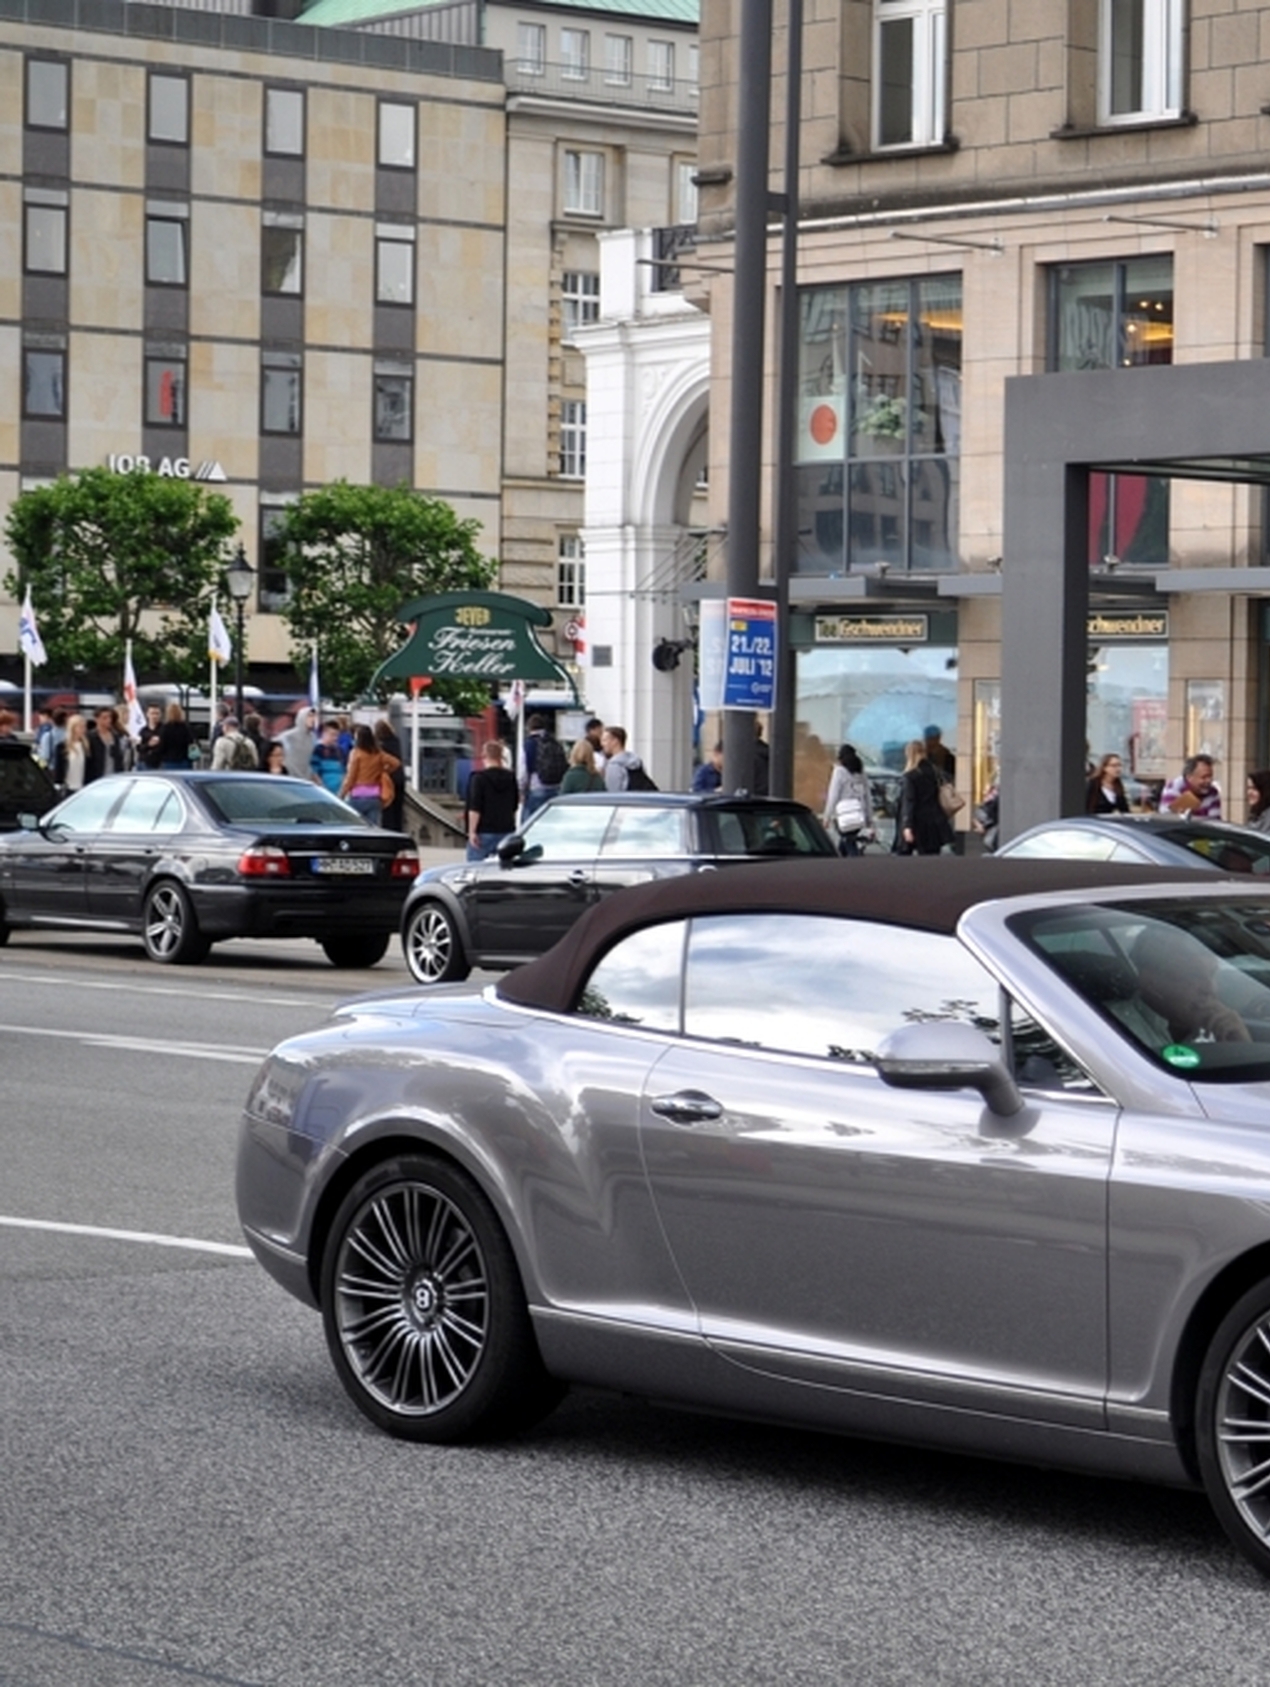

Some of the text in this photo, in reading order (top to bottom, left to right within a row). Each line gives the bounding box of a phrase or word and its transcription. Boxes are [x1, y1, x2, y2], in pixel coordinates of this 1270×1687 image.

[157, 457, 190, 478] AG
[428, 627, 516, 650] Friesen
[428, 650, 516, 674] Keller
[729, 657, 755, 675] JULI
